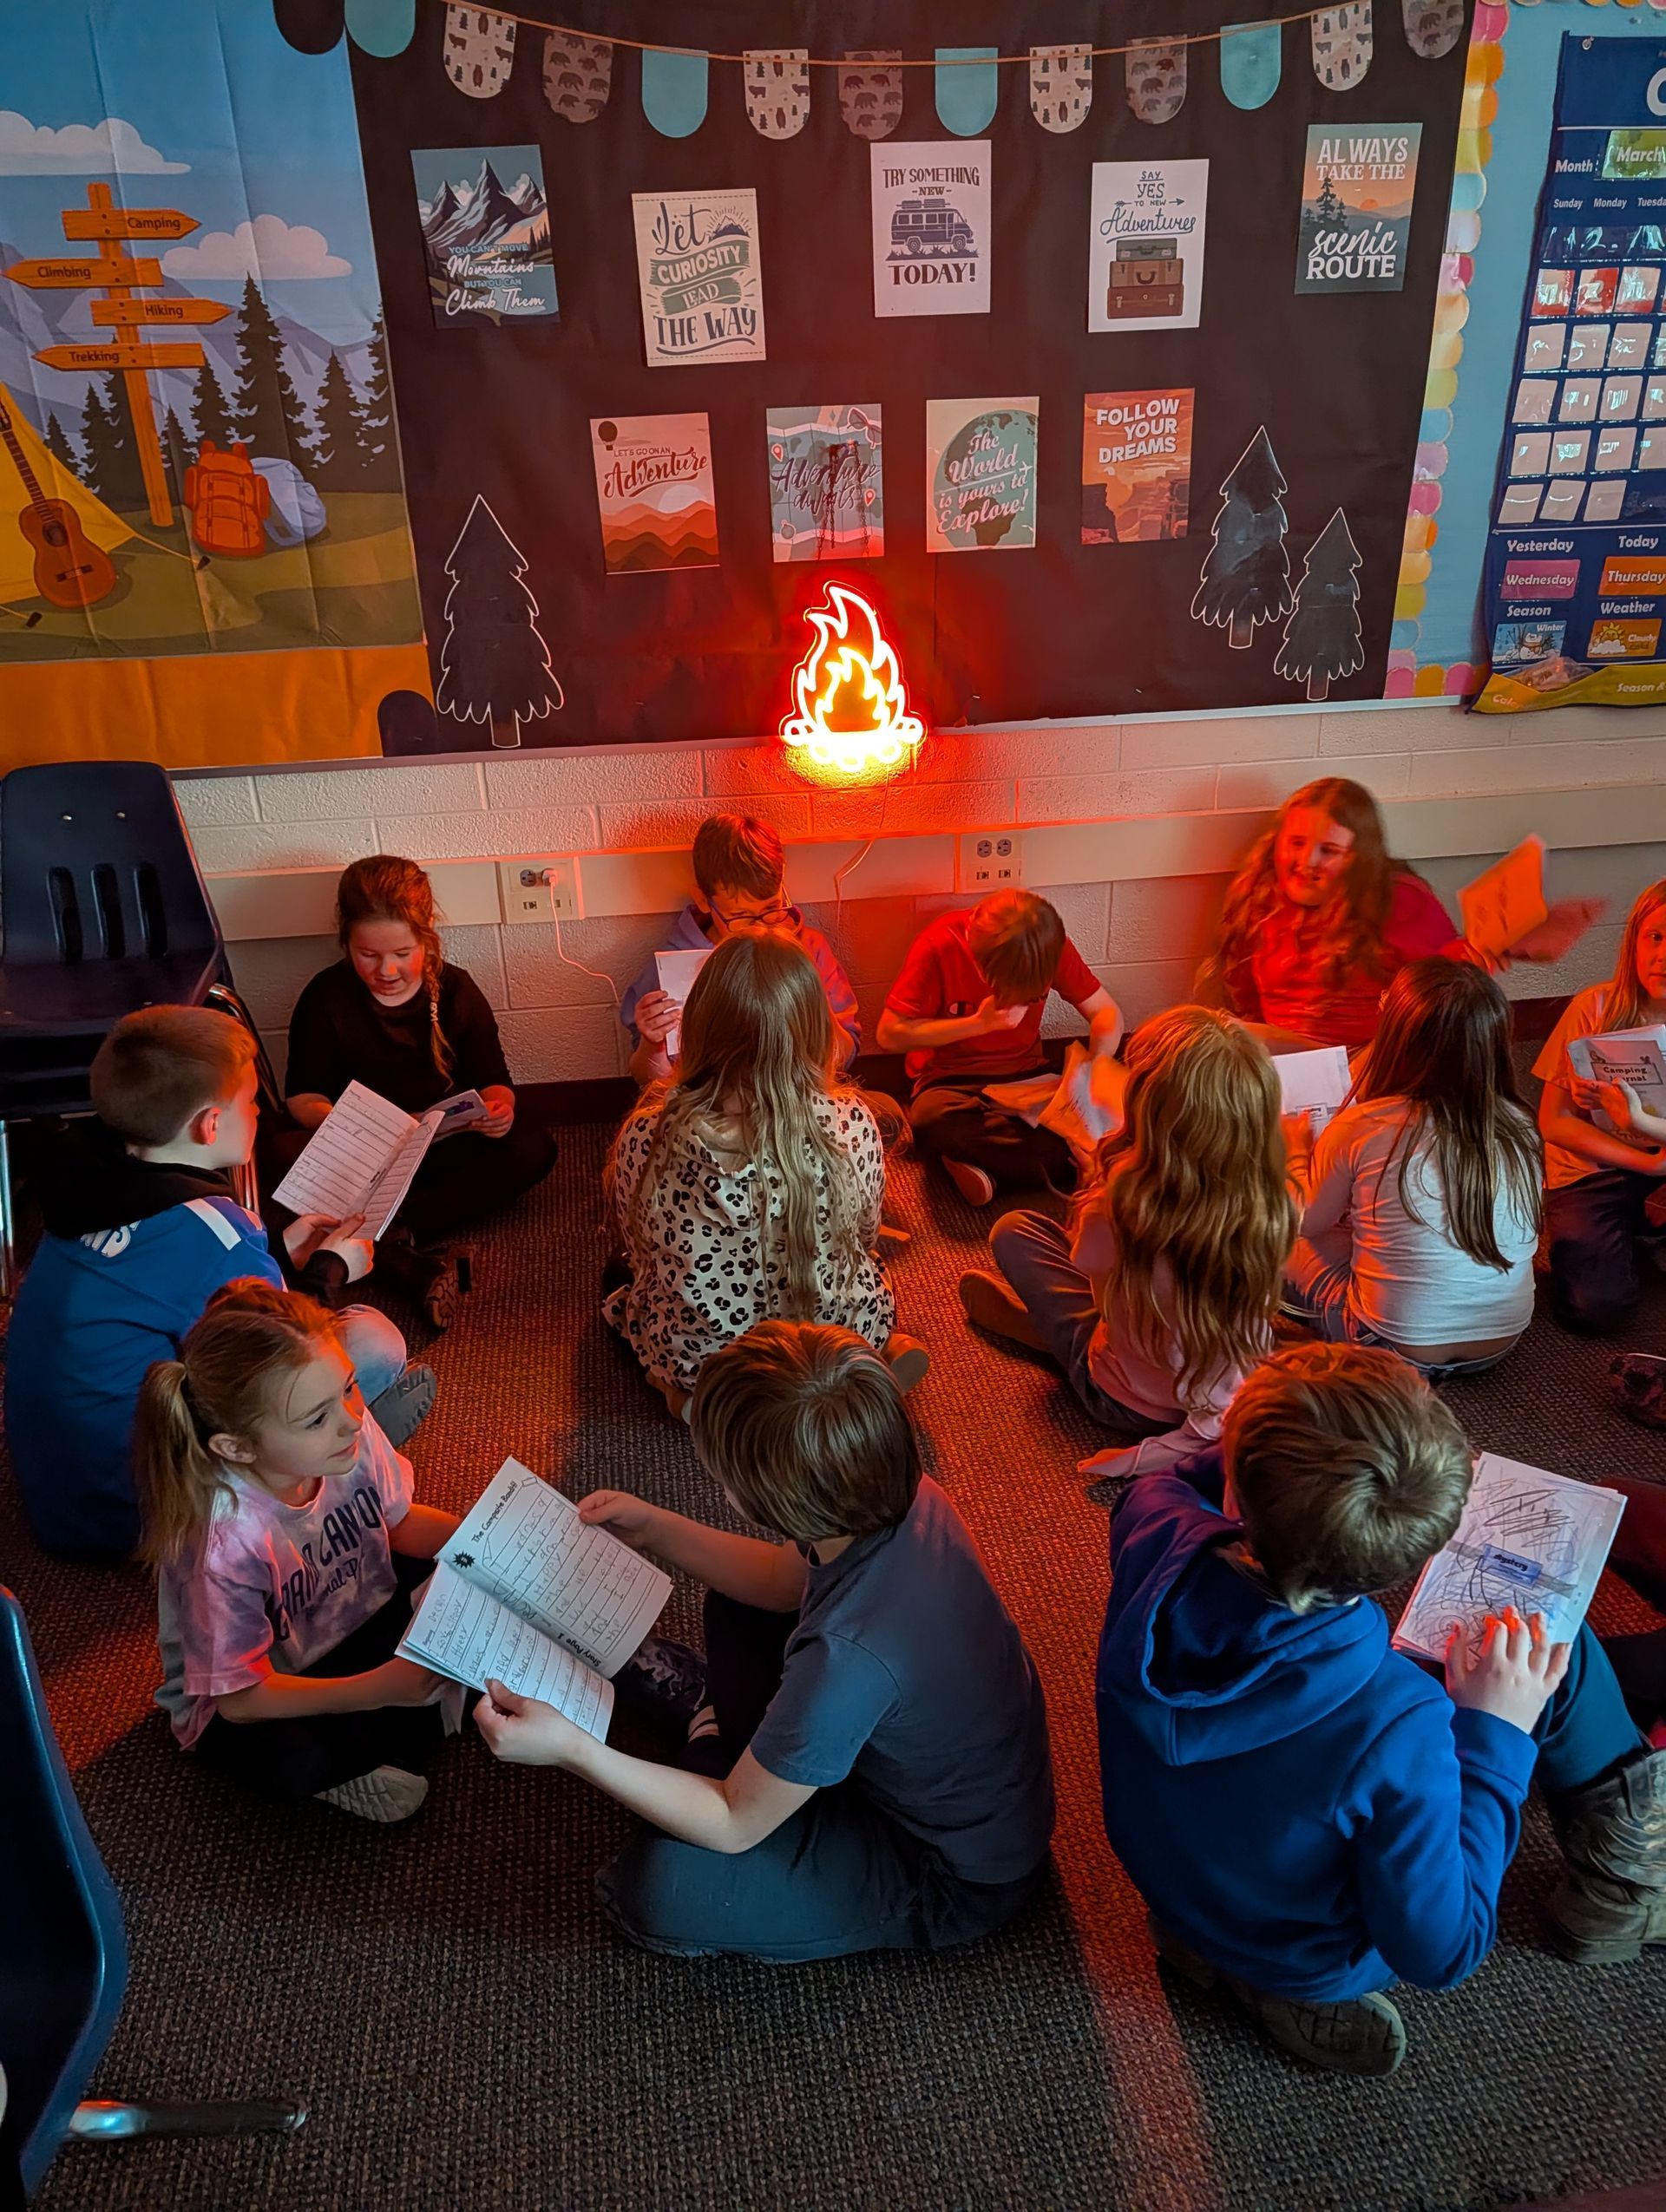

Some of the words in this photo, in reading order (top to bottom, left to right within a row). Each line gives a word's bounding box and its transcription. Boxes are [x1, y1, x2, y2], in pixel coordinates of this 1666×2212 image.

[1316, 137, 1408, 164] ALWAYS
[1554, 159, 1593, 173] Month
[1617, 146, 1663, 162] March
[882, 168, 907, 188] TRY
[908, 166, 981, 187] SOMETHING
[1141, 171, 1162, 180] SAY
[1316, 165, 1364, 180] TAKE
[1369, 164, 1406, 180] THE
[1137, 183, 1165, 199] YES
[1150, 199, 1167, 207] NEW
[1553, 198, 1584, 210] Sunday
[1593, 197, 1628, 210] Monday
[1637, 196, 1666, 207] Tuesda
[127, 217, 181, 232] Camping
[655, 201, 712, 256] Let
[1099, 206, 1197, 236] Adventures
[1308, 221, 1398, 259] scenic
[37, 265, 91, 280] Climbing
[447, 254, 535, 278] Mountains
[657, 245, 741, 284] CURIOSITY
[888, 262, 977, 285] TODAY!
[1305, 255, 1396, 279] ROUTE
[503, 278, 522, 286] CAN
[446, 289, 496, 316] Climb
[502, 287, 545, 311] Them
[682, 286, 719, 308] LEAD
[145, 304, 184, 319] Hiking
[653, 313, 698, 347] THE
[704, 306, 757, 341] WAY
[69, 350, 120, 364] Trekking
[1096, 398, 1180, 426] FOLLOW
[1124, 417, 1177, 442] YOUR
[967, 429, 1000, 455] The
[1098, 435, 1177, 465] DREAMS
[604, 447, 708, 498] Adventure
[948, 443, 1020, 484] World
[939, 492, 952, 508] is
[958, 482, 1006, 509] yours
[1011, 470, 1028, 488] to
[937, 488, 1029, 534] Explore!
[1506, 538, 1574, 553] Yesterday
[1618, 534, 1659, 549] Today
[1506, 574, 1576, 586] Wednesday
[1608, 570, 1666, 585] Thursday
[1506, 605, 1551, 618] Season
[1600, 601, 1656, 615] Weather
[1536, 624, 1564, 632] Winter
[1617, 684, 1655, 692] Season
[1603, 1066, 1648, 1075] Camping
[470, 1528, 485, 1544] The
[481, 1500, 505, 1531] Campsite
[565, 1636, 583, 1653] Page
[582, 1650, 602, 1667] Story
